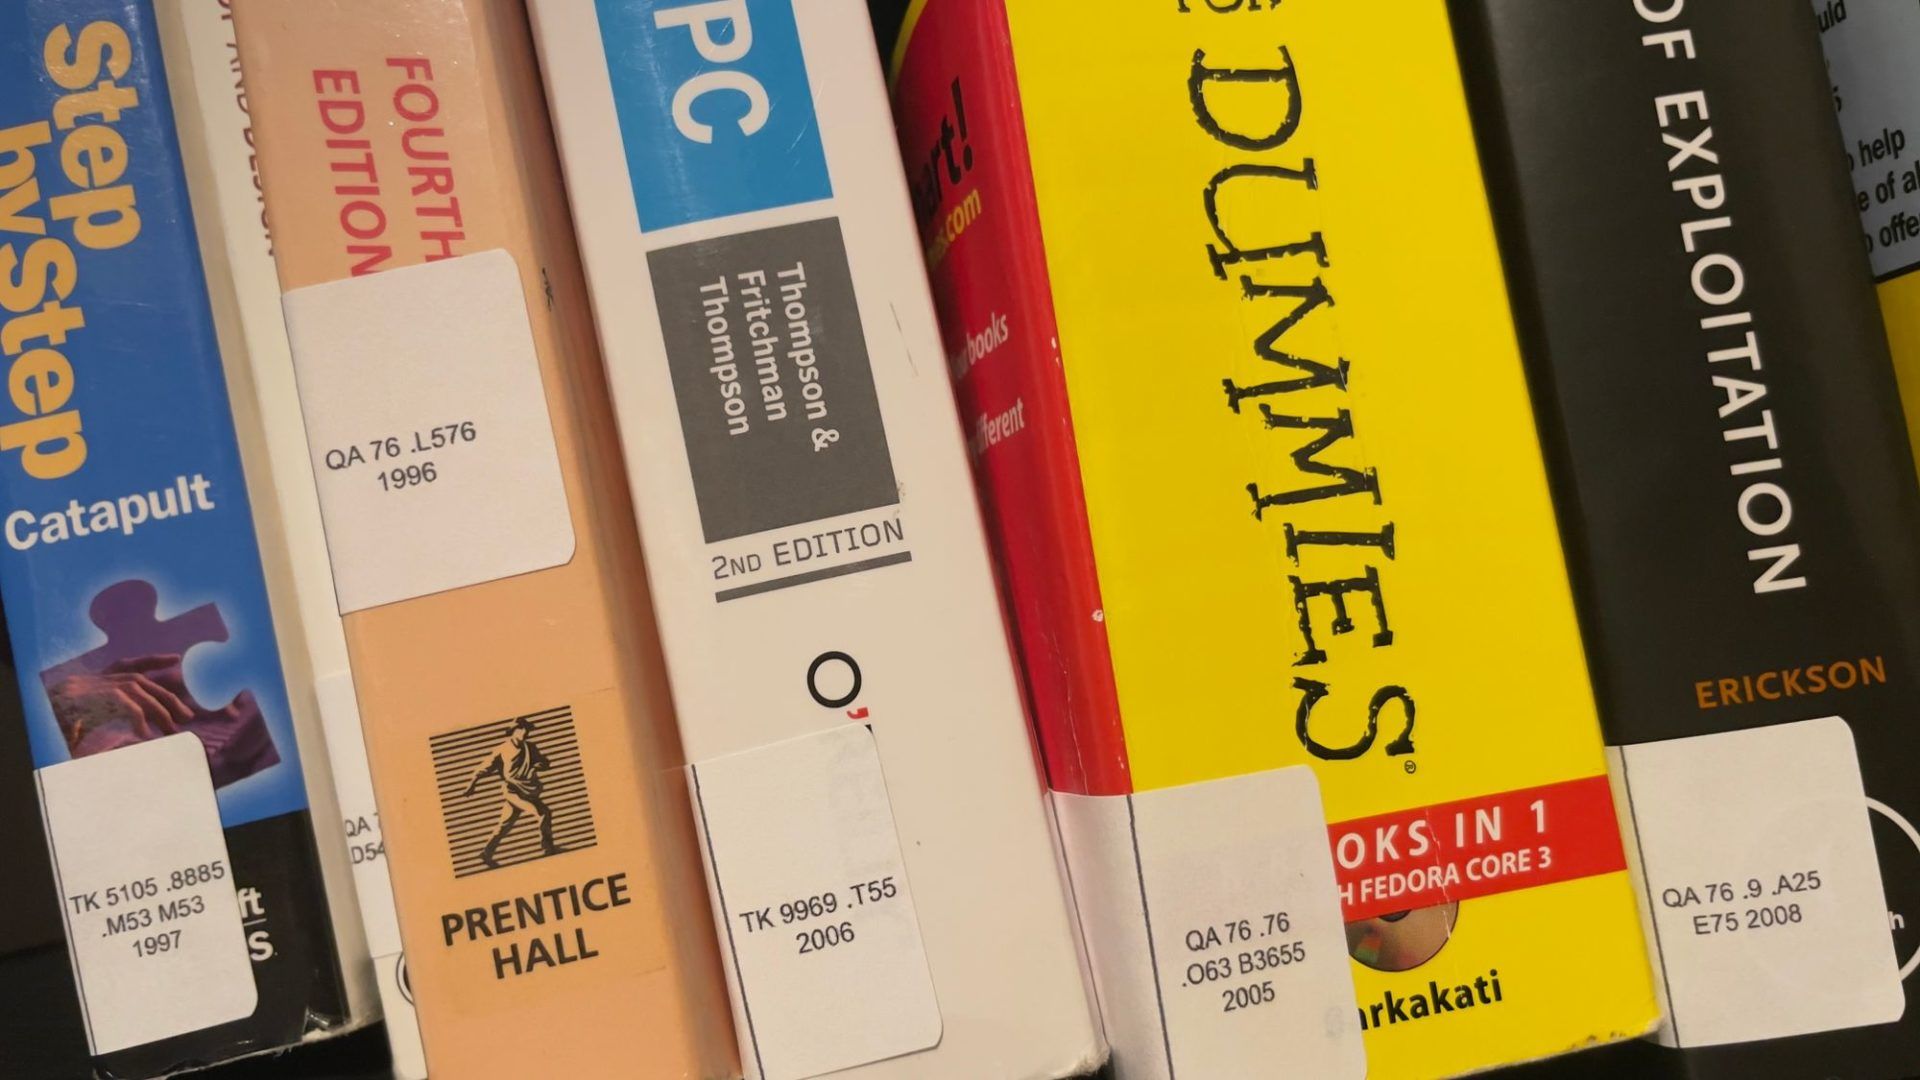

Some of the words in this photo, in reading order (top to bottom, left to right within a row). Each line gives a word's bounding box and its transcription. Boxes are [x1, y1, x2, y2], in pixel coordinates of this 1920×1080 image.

[653, 0, 770, 145] PC
[43, 20, 142, 250] Step
[386, 58, 466, 263] FOURTH
[1858, 127, 1905, 168] help
[312, 70, 393, 278] EDITION
[1875, 170, 1895, 204] of
[700, 276, 750, 436] Thompson
[738, 270, 788, 421] Fritchman
[777, 262, 828, 420] Thompson
[811, 428, 840, 452] &
[966, 312, 1009, 366] books
[1654, 90, 1807, 594] EXPLOITATION
[1188, 45, 1415, 757] DUMMIES
[325, 445, 366, 471] QA
[369, 437, 401, 461] 76
[411, 421, 477, 453] .L576
[377, 461, 438, 492] 1996
[4, 474, 215, 552] Catapult
[711, 553, 762, 580] 2ND
[773, 517, 905, 567] EDITION
[1695, 656, 1887, 709] ERICKSON
[1455, 806, 1501, 848] IN
[1530, 800, 1545, 834] 1
[69, 891, 101, 915] TK
[106, 877, 158, 907] 5105
[166, 860, 226, 892] .8885
[1360, 862, 1460, 904] FEDORA
[1465, 848, 1532, 882] CORE
[1538, 846, 1552, 869] 3
[1662, 886, 1701, 908] QA
[1705, 883, 1734, 903] 76
[1743, 878, 1762, 900] .9
[1772, 870, 1822, 896] .A25
[102, 908, 152, 938] .M53
[158, 895, 206, 923] M53
[441, 872, 632, 947] PRENTICE
[739, 907, 776, 933] TK
[780, 892, 837, 924] 9969
[847, 876, 897, 909] .T55
[1185, 926, 1222, 952] QA
[1225, 919, 1252, 943] 76
[1260, 911, 1291, 938] .76
[1693, 911, 1739, 936] E75
[1745, 903, 1802, 929] 2008
[132, 930, 182, 958] 1997
[492, 928, 599, 980] HALL
[796, 921, 855, 954] 2006
[1238, 941, 1306, 975] B3655
[1222, 981, 1275, 1013] 2005
